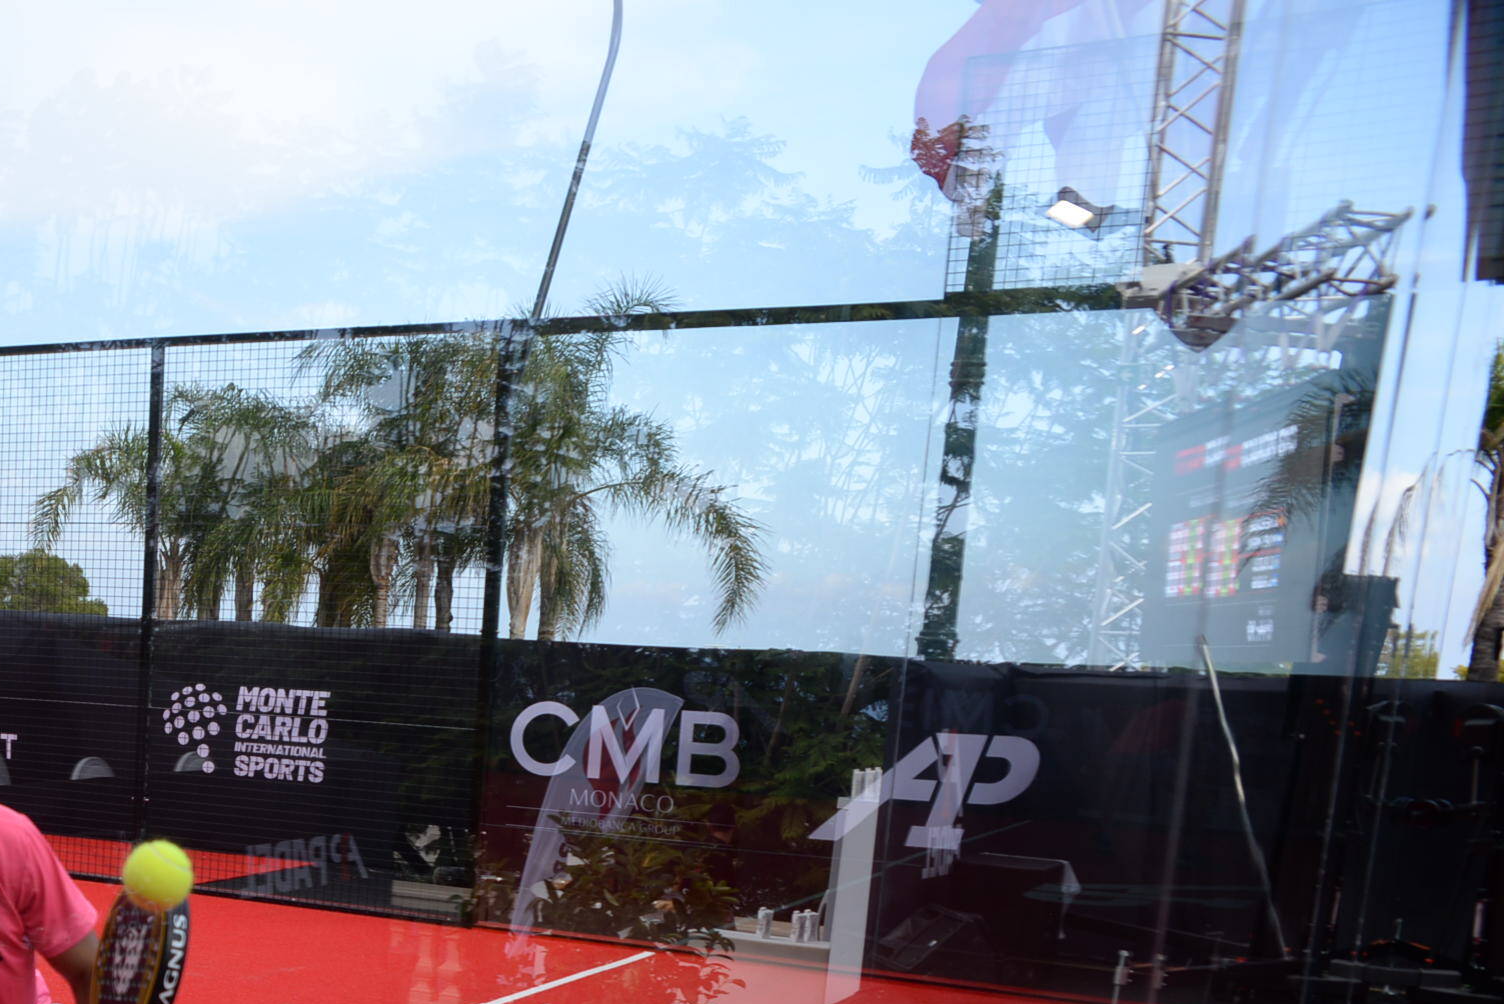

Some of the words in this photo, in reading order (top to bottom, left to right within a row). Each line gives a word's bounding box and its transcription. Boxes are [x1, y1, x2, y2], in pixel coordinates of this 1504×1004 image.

[236, 686, 331, 716] MONTE
[235, 713, 329, 744] CARLO
[234, 741, 327, 759] INTERNATIONAL
[510, 700, 740, 788] CMB
[233, 754, 325, 783] SPORTS
[569, 788, 674, 814] MONACO
[638, 822, 681, 835] GROUP
